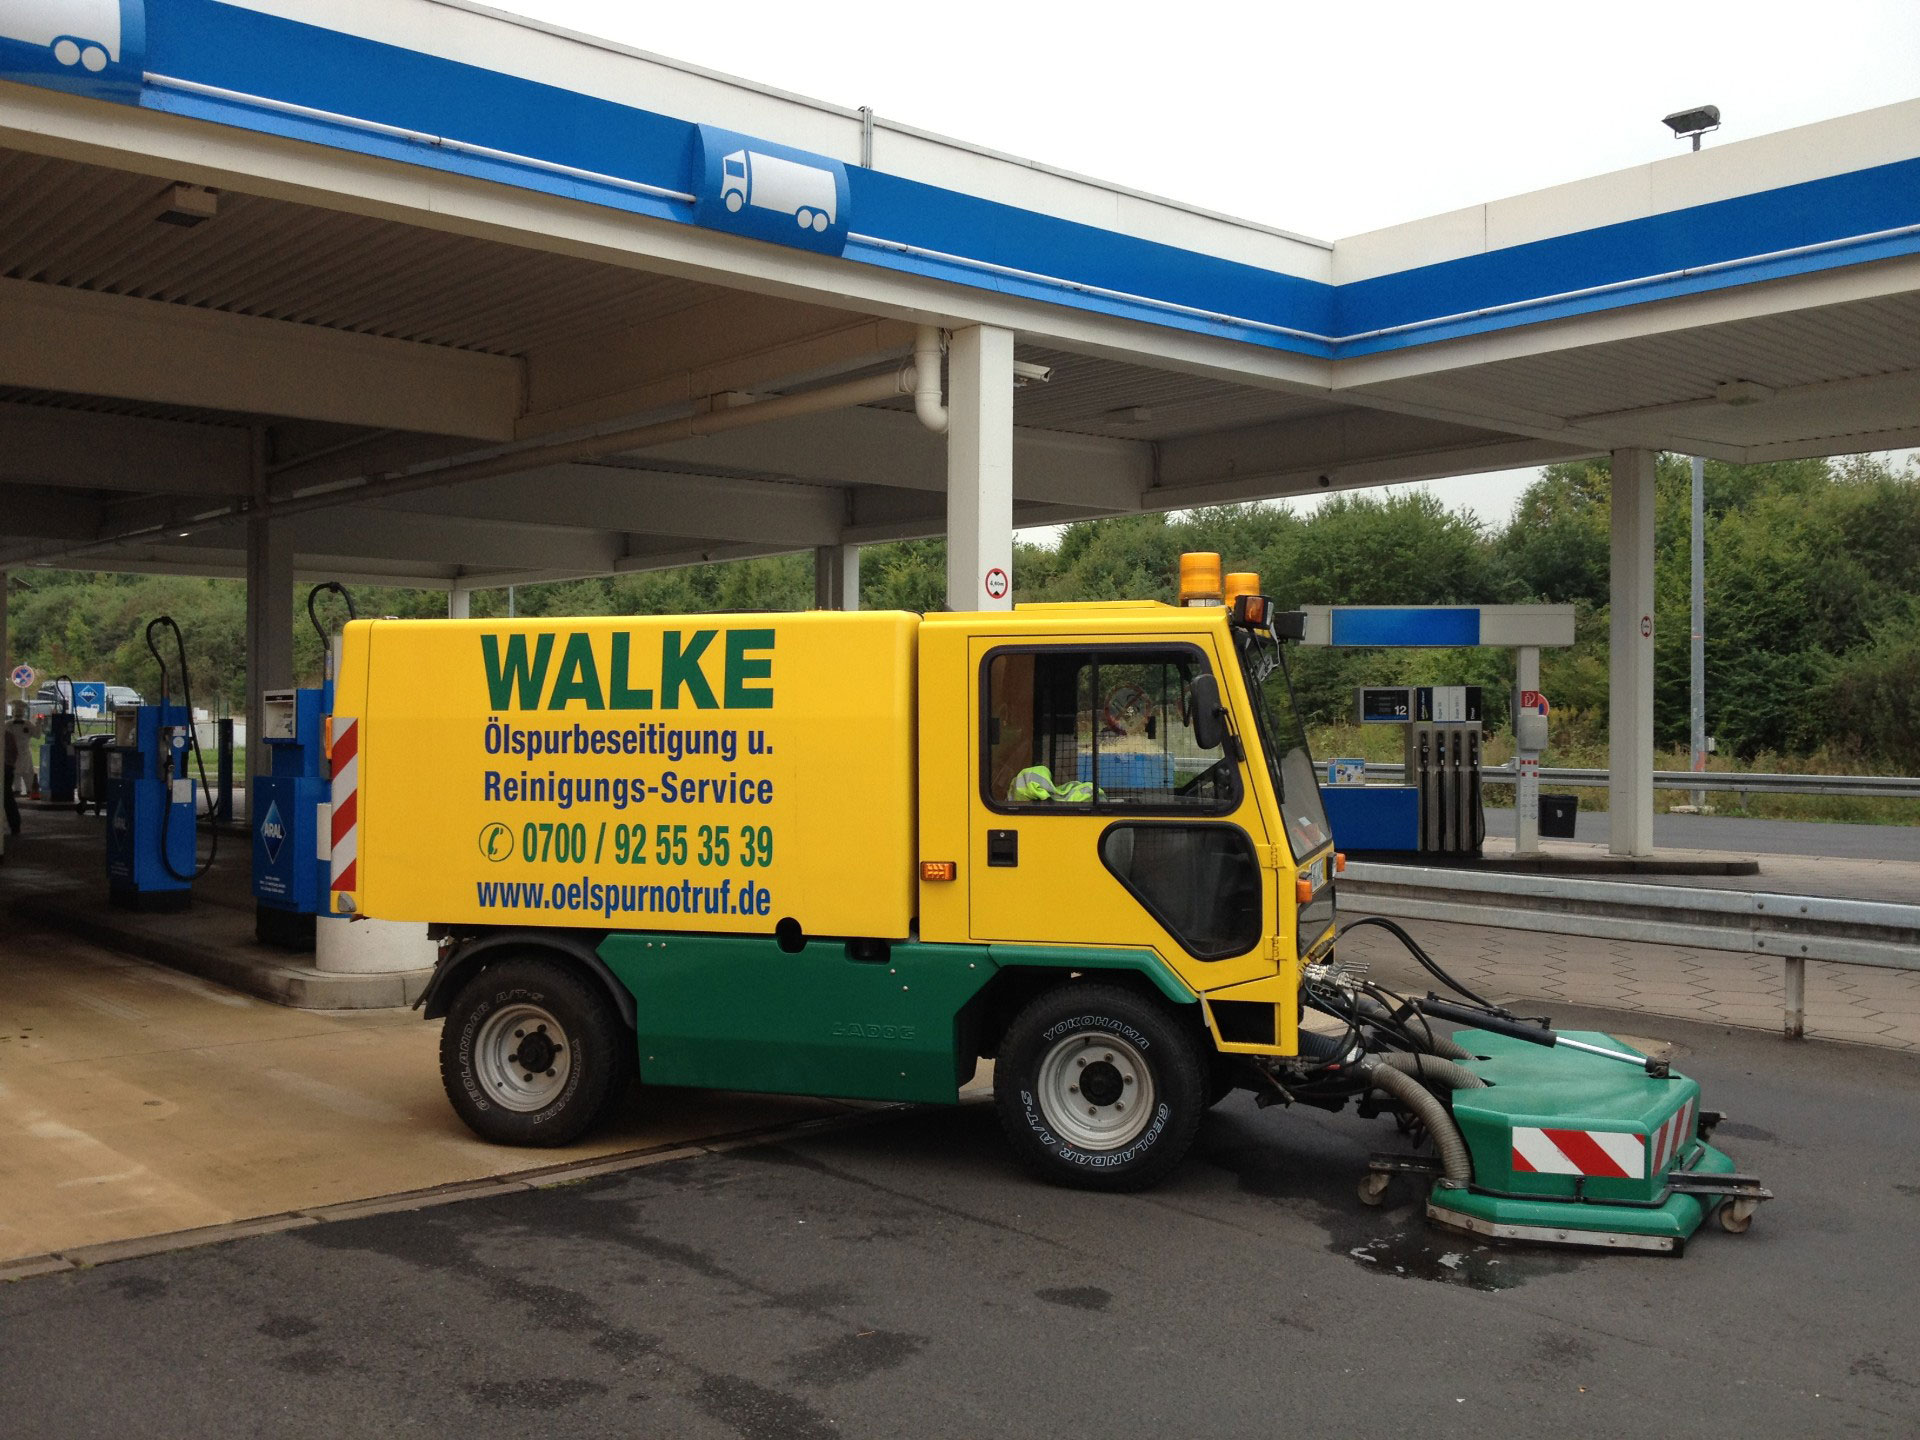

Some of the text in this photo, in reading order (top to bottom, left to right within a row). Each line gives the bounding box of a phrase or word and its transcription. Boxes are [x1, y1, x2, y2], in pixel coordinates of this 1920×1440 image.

[480, 629, 775, 711] WALKE
[1394, 705, 1407, 716] 12
[484, 716, 774, 762] Ölspurbeseitigung u.
[484, 770, 774, 810] Reinigungs-Service
[264, 822, 282, 839] ARAL
[522, 822, 587, 864] 0700
[614, 823, 647, 865] 92
[655, 824, 688, 866] 55
[697, 825, 730, 867] 35
[739, 825, 774, 868] 39
[476, 876, 771, 919] www.oelspurnotruf.de
[1043, 1016, 1150, 1050] YOKOHAMA
[1059, 1103, 1169, 1167] GEOLANDAR
